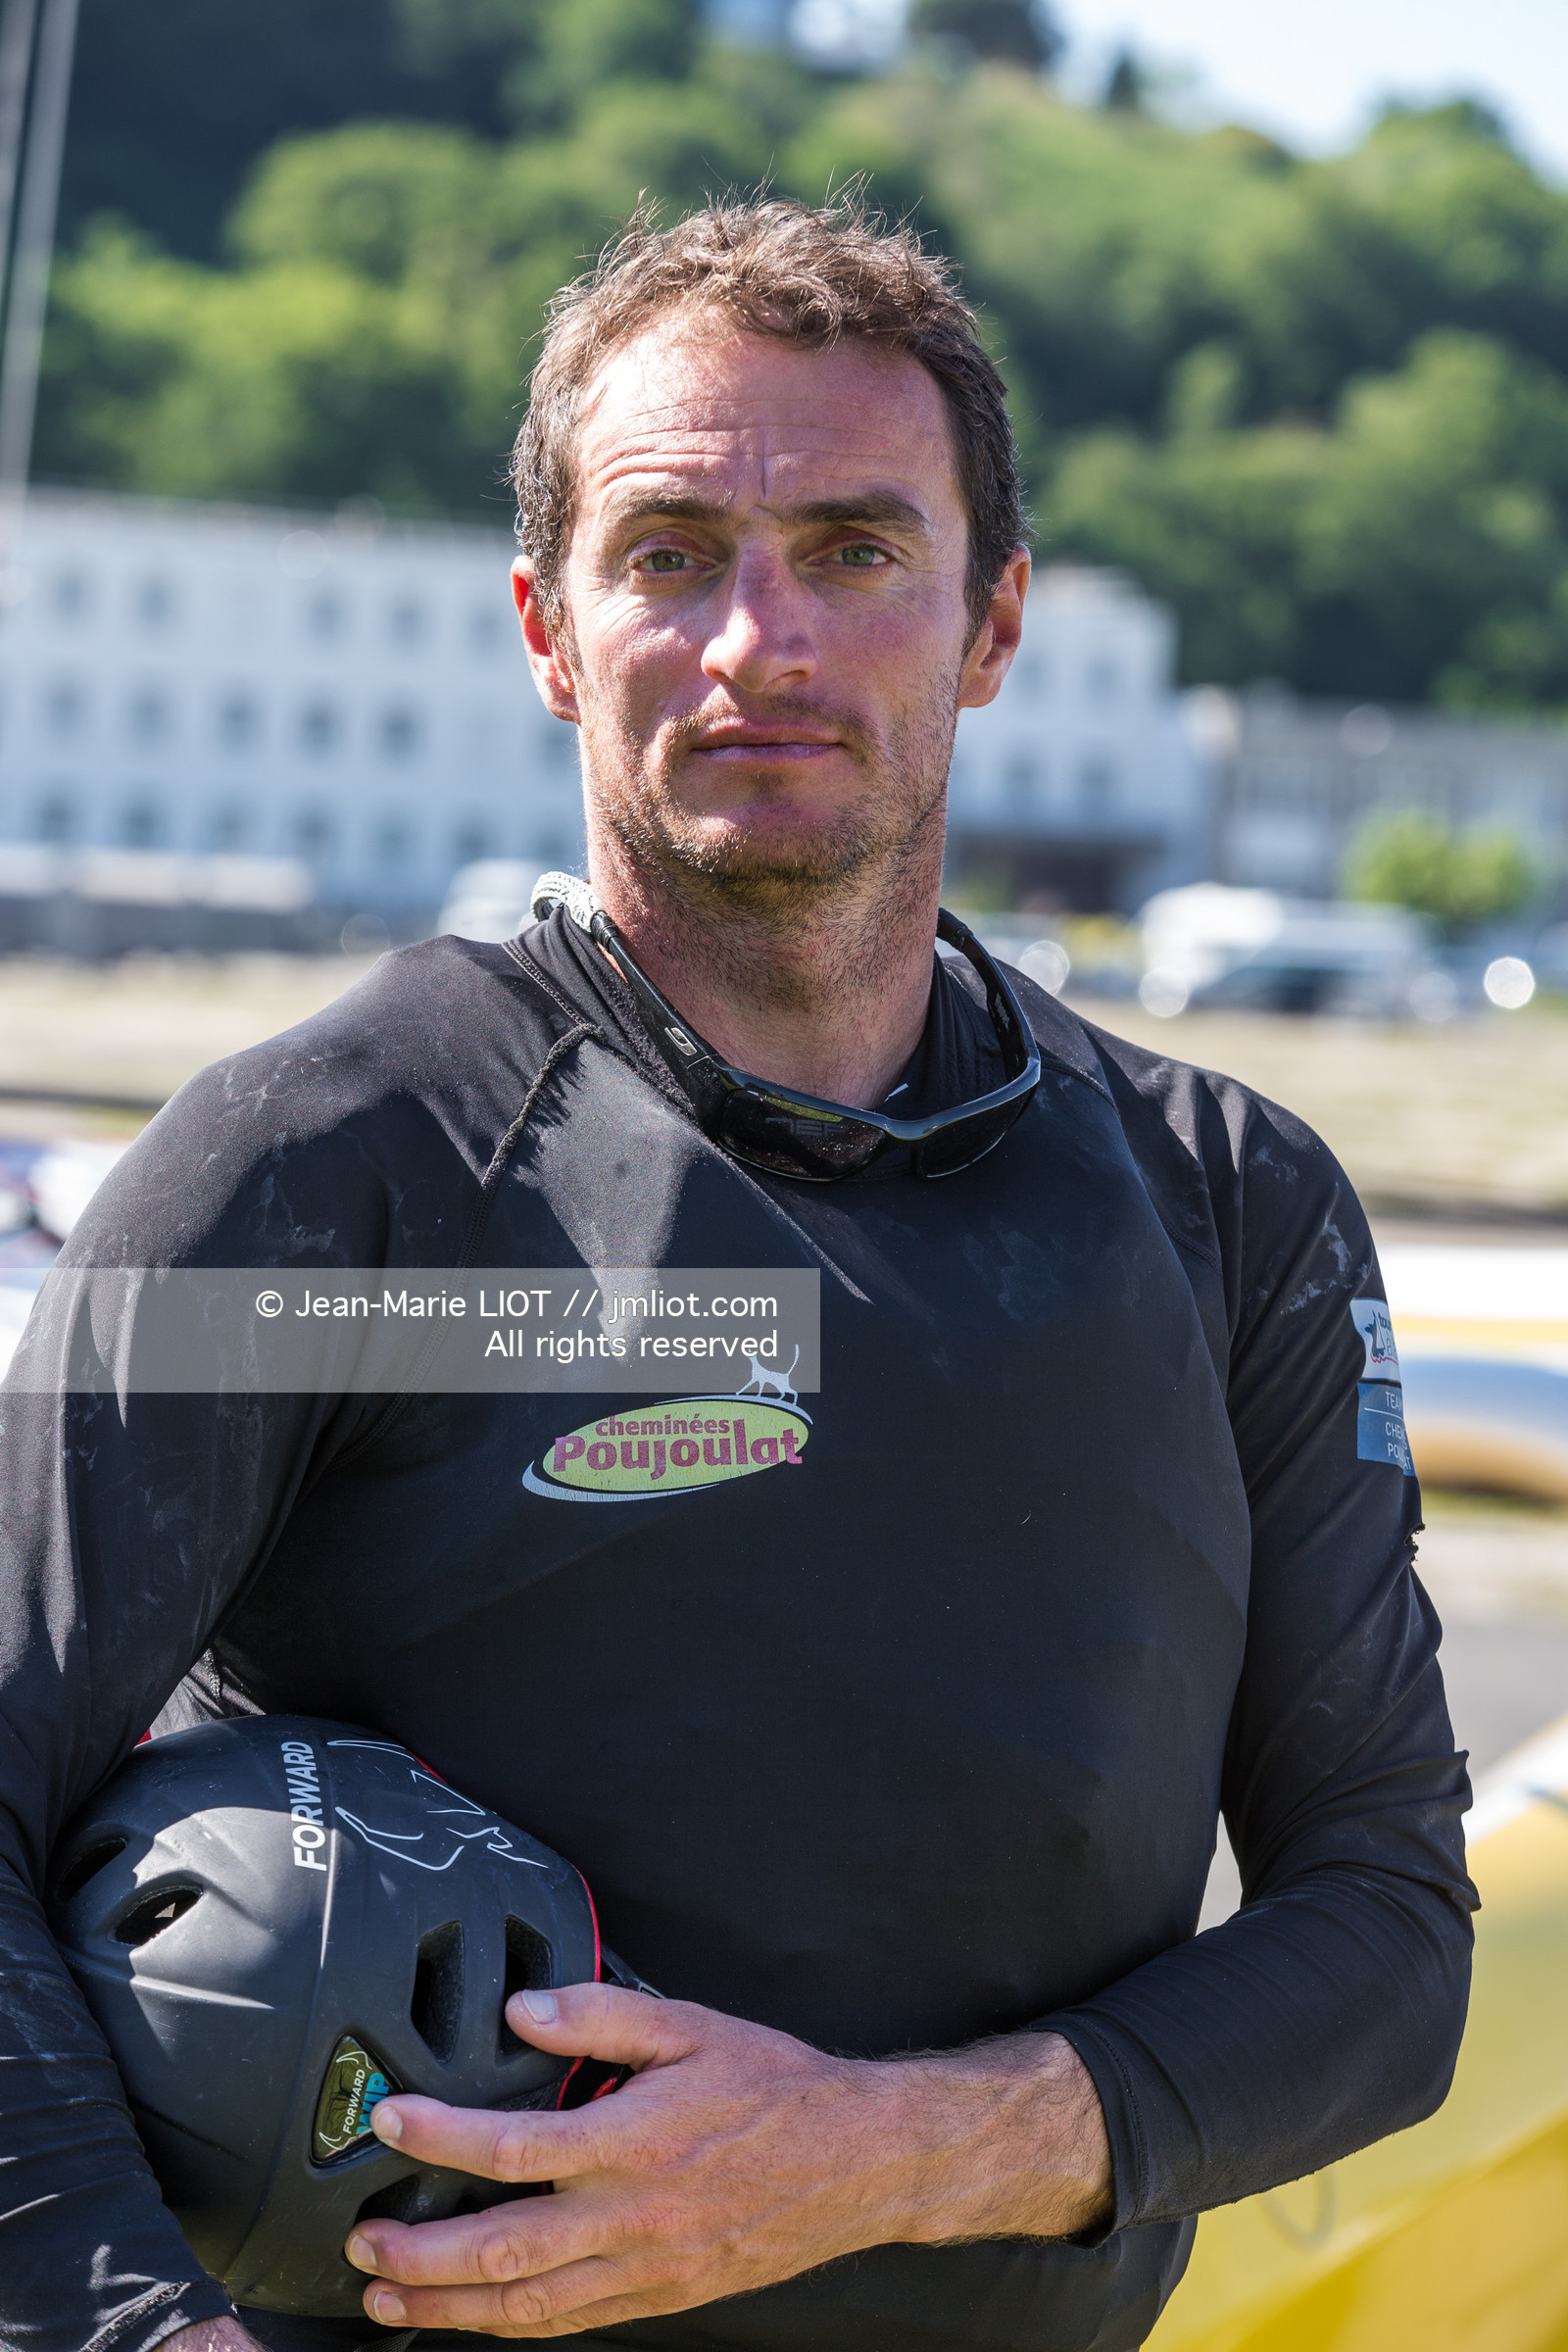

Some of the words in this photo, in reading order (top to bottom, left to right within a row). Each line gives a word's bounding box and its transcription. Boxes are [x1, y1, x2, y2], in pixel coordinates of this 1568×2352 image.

[553, 1418, 804, 1481] Poujoulat
[595, 1414, 731, 1437] cheminées
[280, 1740, 328, 1872] FORWARD
[342, 2069, 366, 2134] FORWARD
